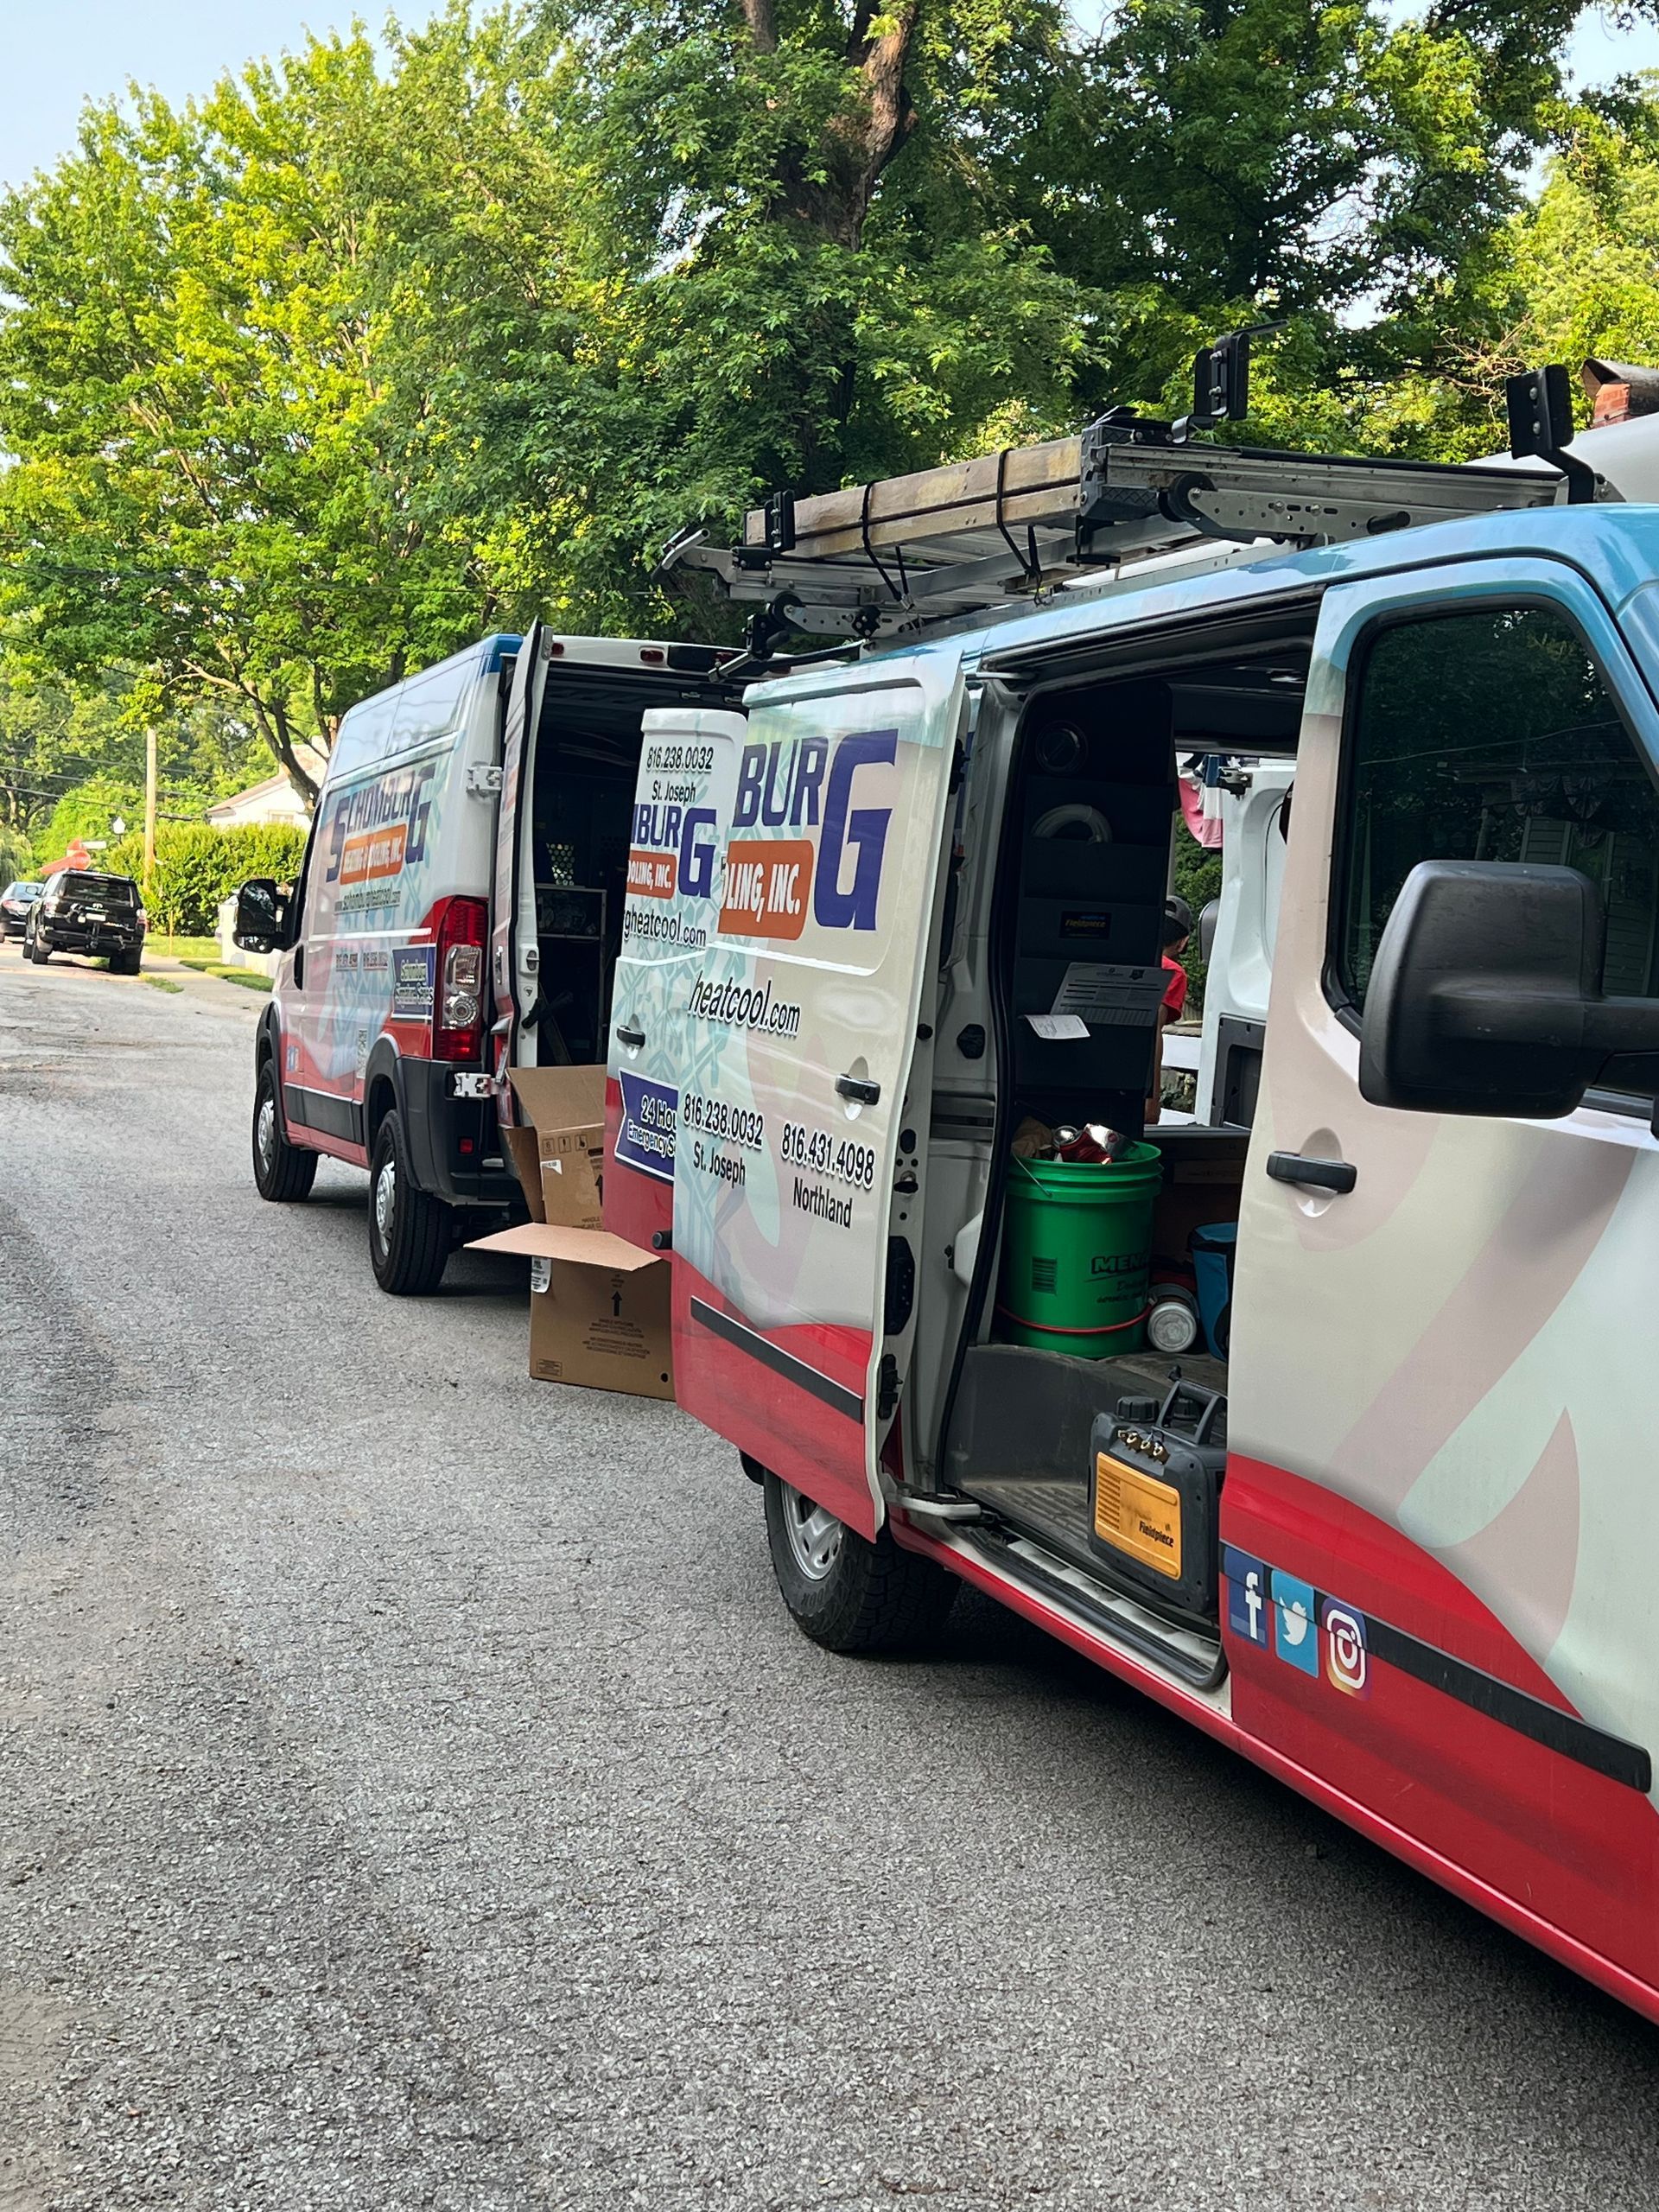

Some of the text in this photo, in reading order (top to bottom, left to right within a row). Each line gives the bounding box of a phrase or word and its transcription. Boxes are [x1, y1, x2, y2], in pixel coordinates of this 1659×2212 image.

[646, 746, 714, 770] 816.238.0032
[652, 779, 696, 807] St. Joseph
[732, 728, 899, 930] BURG
[655, 863, 672, 888] INC.
[767, 863, 800, 915] INC.
[622, 904, 706, 947] gheatcool.com
[688, 969, 800, 1033] heatcool.com
[641, 1095, 655, 1124] 24
[683, 1093, 764, 1146] 816.238.0032
[627, 1119, 676, 1158] Emergency S
[782, 1122, 874, 1185] 816.431.4098
[693, 1141, 746, 1189] St. Joseph
[793, 1177, 853, 1229] Northland
